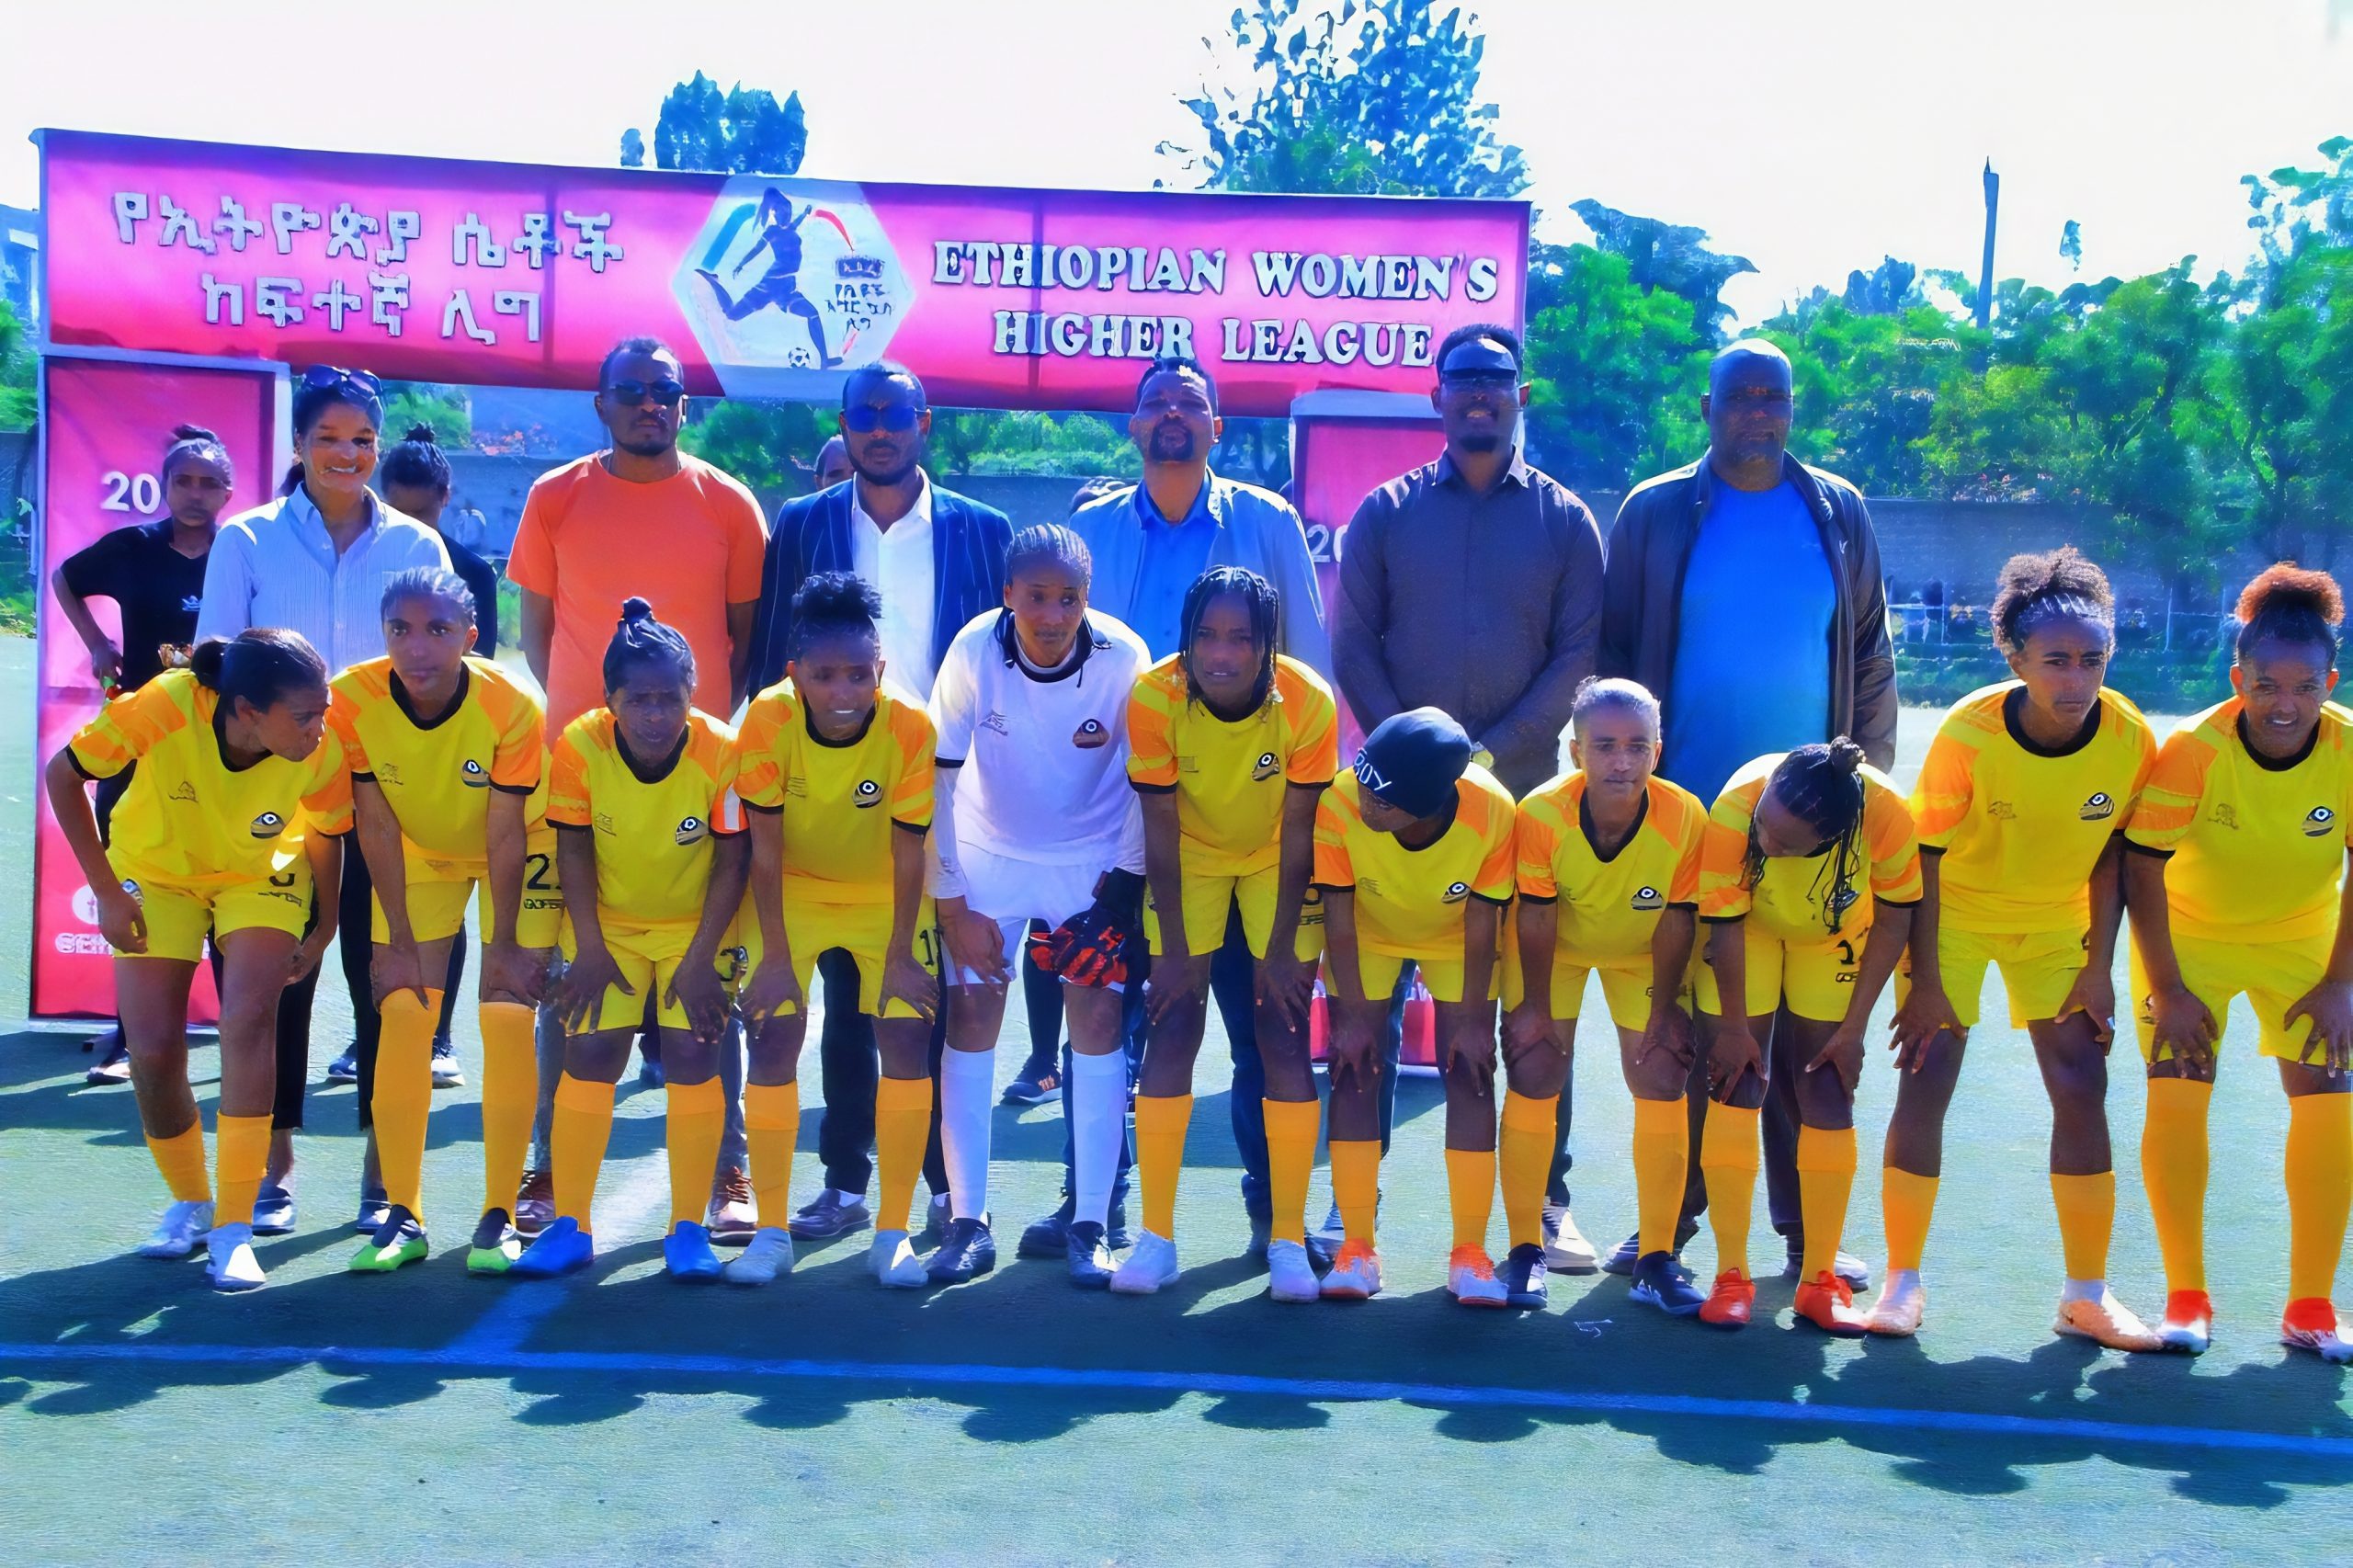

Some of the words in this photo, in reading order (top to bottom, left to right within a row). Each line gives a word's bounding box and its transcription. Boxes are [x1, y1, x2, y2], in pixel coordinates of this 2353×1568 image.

[112, 191, 422, 267] የኢትዮጵያ
[451, 210, 624, 273] ሴቶች
[201, 268, 410, 336] ከፍተኛ
[441, 289, 540, 346] ሊግ
[932, 241, 1226, 294] ETHIOPIAN
[1252, 251, 1498, 303] WOMEN'S
[993, 310, 1195, 359] HIGHER
[1221, 317, 1434, 368] LEAGUE
